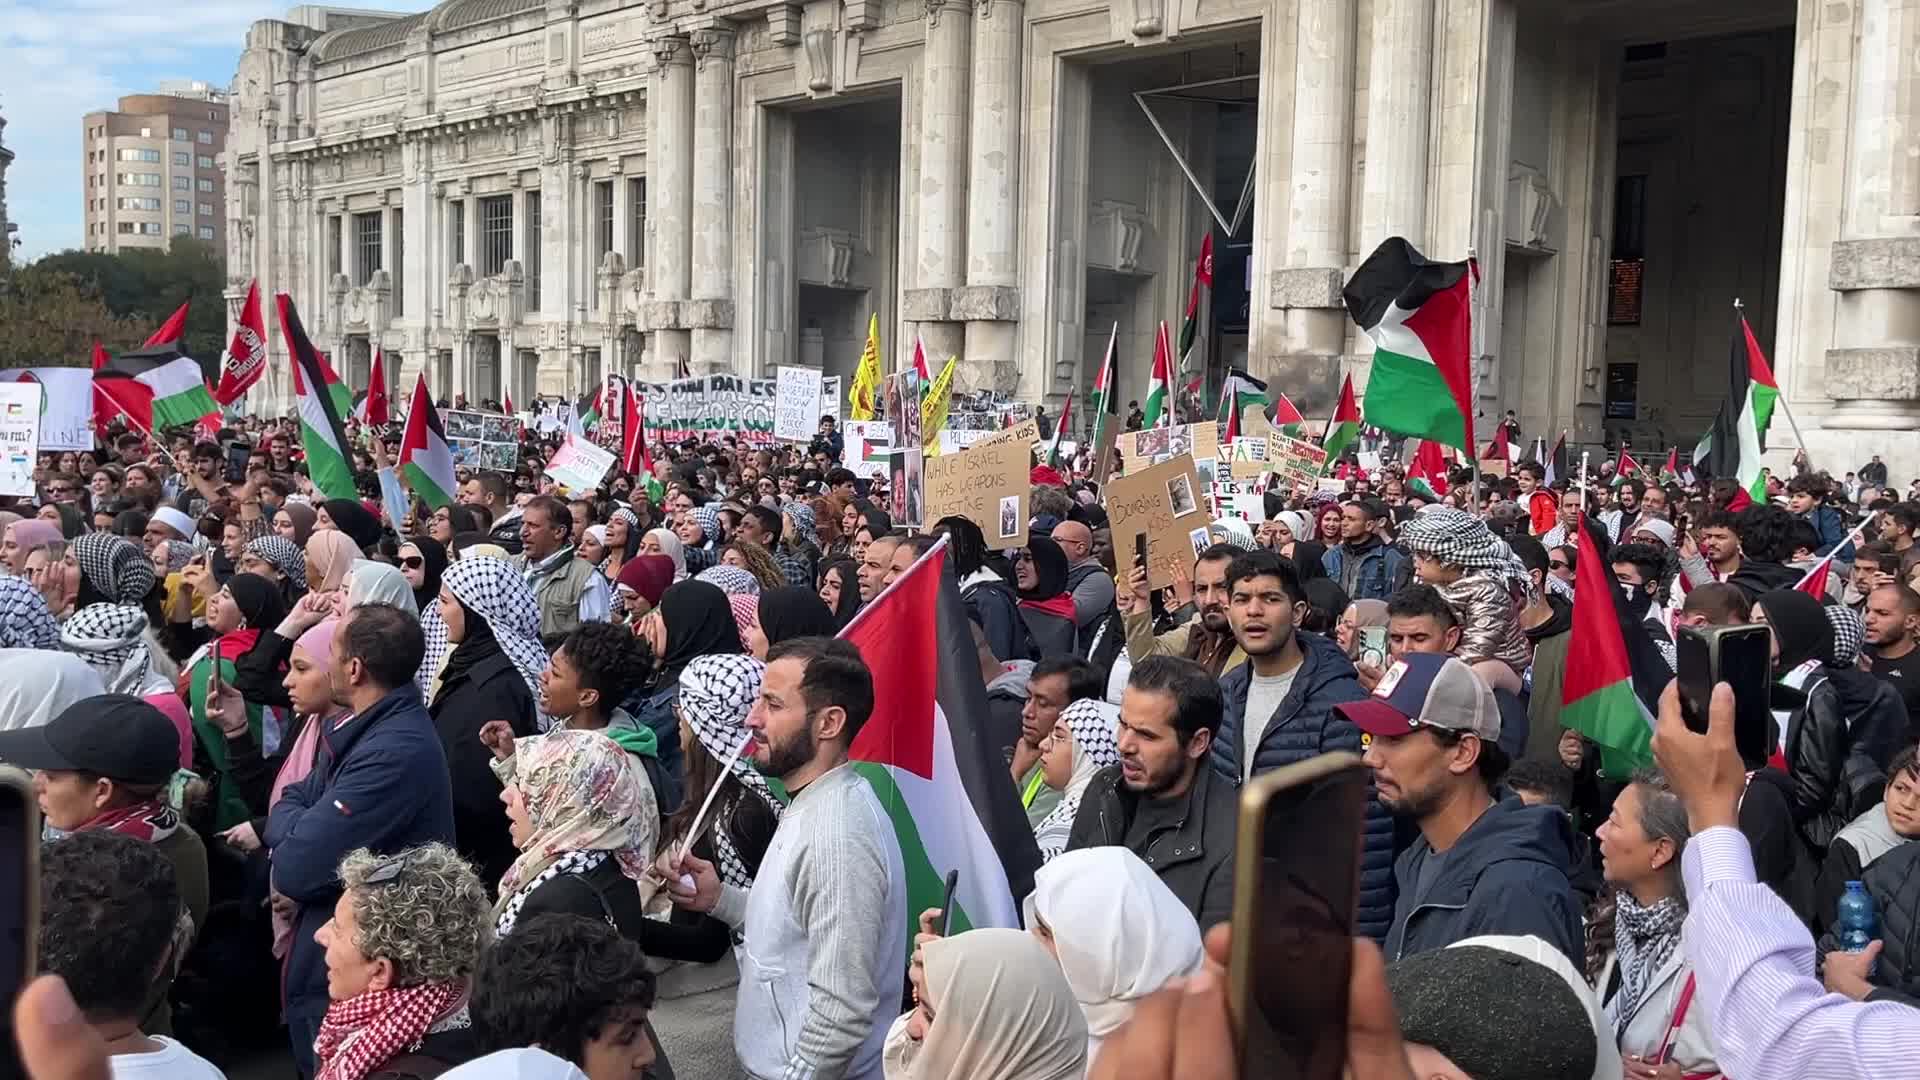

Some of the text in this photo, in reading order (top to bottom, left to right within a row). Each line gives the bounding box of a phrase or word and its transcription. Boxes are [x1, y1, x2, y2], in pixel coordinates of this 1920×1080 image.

[1016, 423, 1034, 440] KIDS
[926, 452, 1005, 480] WHILE ISRAEL
[935, 473, 1007, 498] HAS WEAPONS
[925, 497, 984, 519] PALESTINE
